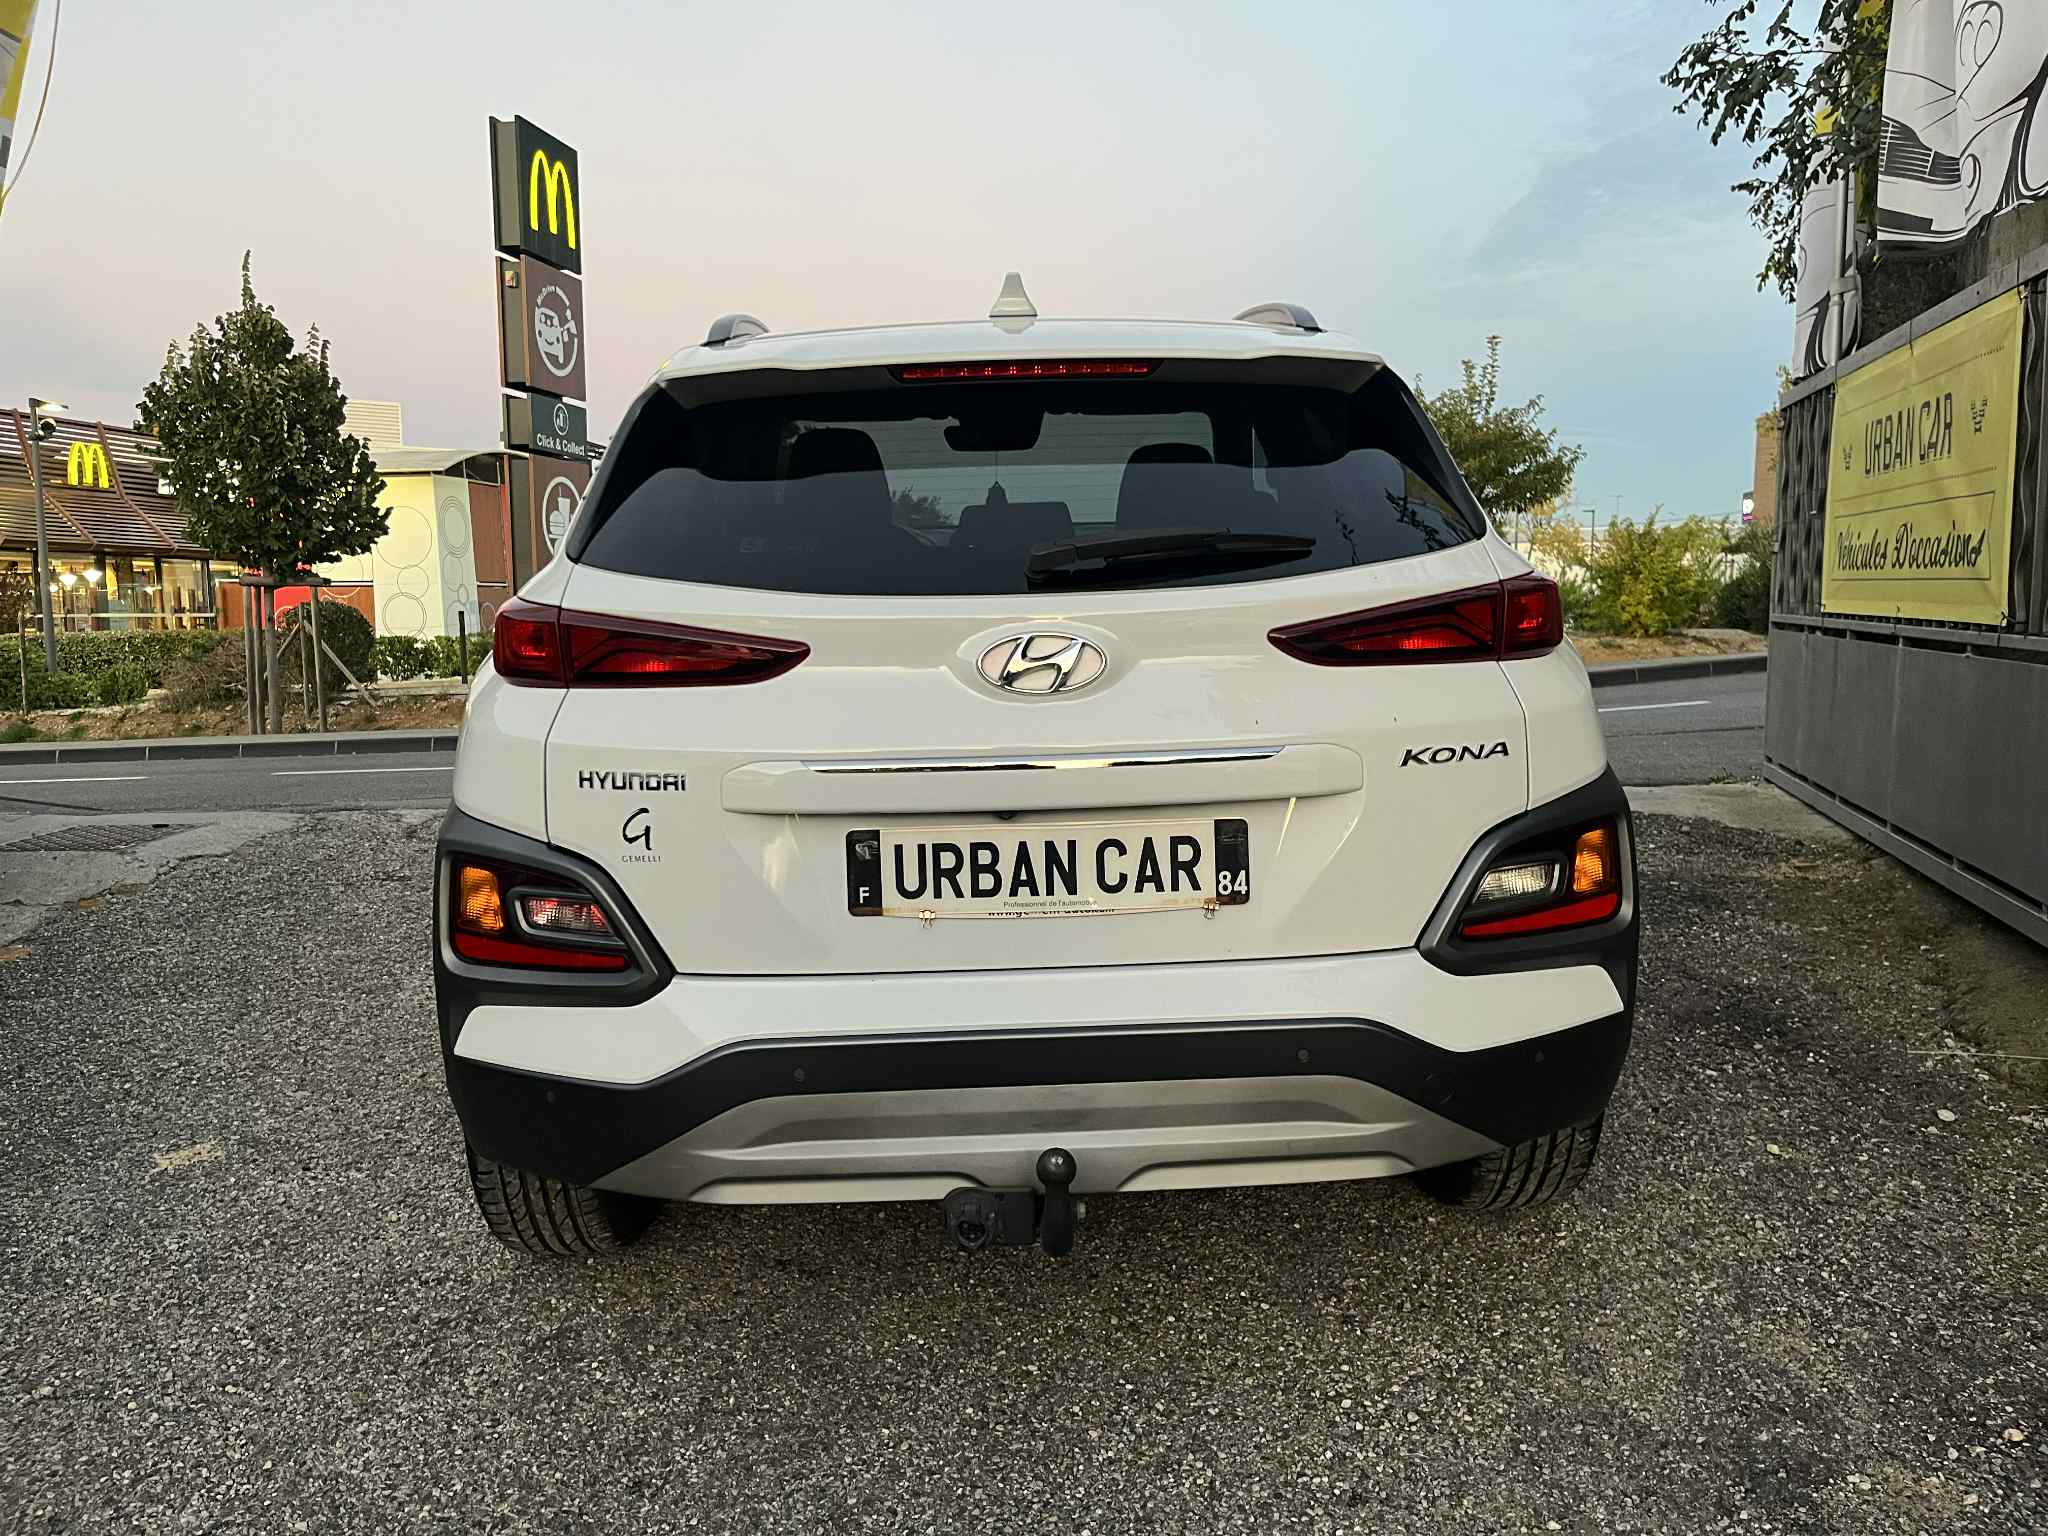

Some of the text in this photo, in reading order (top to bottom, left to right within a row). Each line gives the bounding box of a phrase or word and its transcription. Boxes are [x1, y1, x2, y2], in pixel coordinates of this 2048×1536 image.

[536, 433, 585, 456] Click & Collect
[1864, 392, 1953, 475] URBAN CAR
[1399, 741, 1509, 767] KONA
[578, 770, 686, 791] HYUNDAI
[621, 855, 662, 863] GEMELLI
[893, 835, 1202, 900] URBAN CAR
[1218, 869, 1248, 895] 84
[859, 886, 870, 904] F
